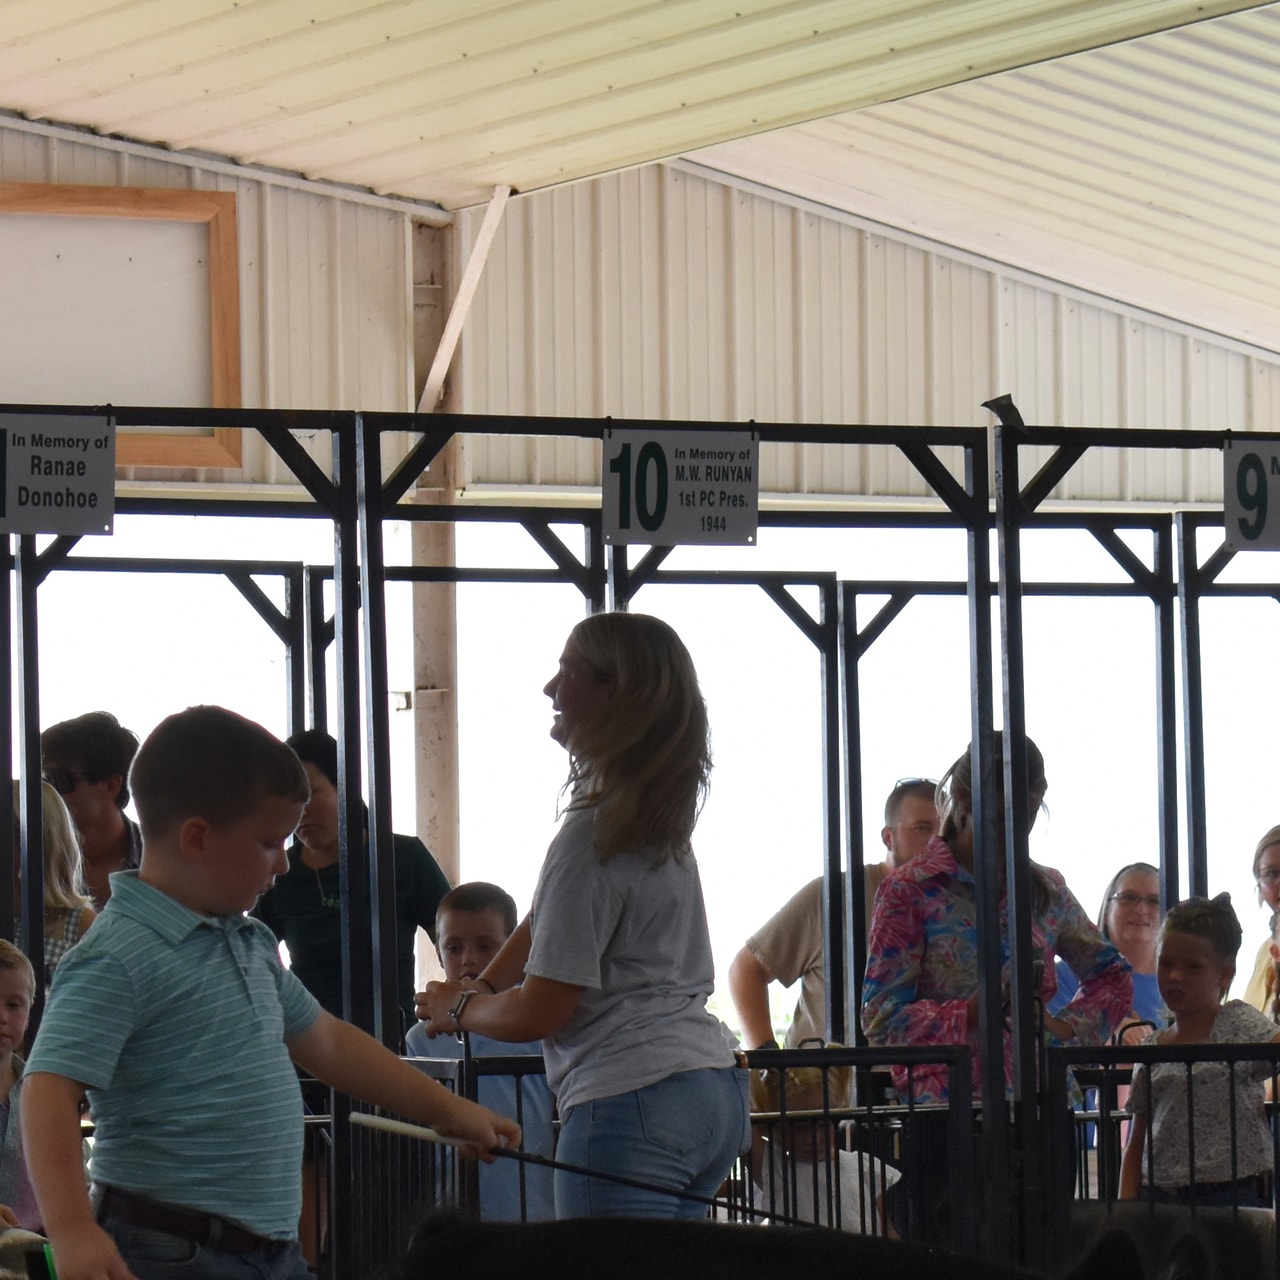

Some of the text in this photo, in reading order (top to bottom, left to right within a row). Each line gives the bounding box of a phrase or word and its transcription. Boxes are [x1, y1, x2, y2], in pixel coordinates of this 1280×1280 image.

[12, 433, 109, 452] In Memory of
[675, 448, 751, 462] In Memory of
[30, 455, 86, 476] Ranae
[675, 465, 752, 482] M.W. RUNYAN
[609, 441, 668, 532] 10
[18, 486, 98, 508] Donohoe
[679, 491, 749, 507] 1st PC Pres.
[1236, 452, 1268, 541] 9
[700, 516, 727, 532] 1944
